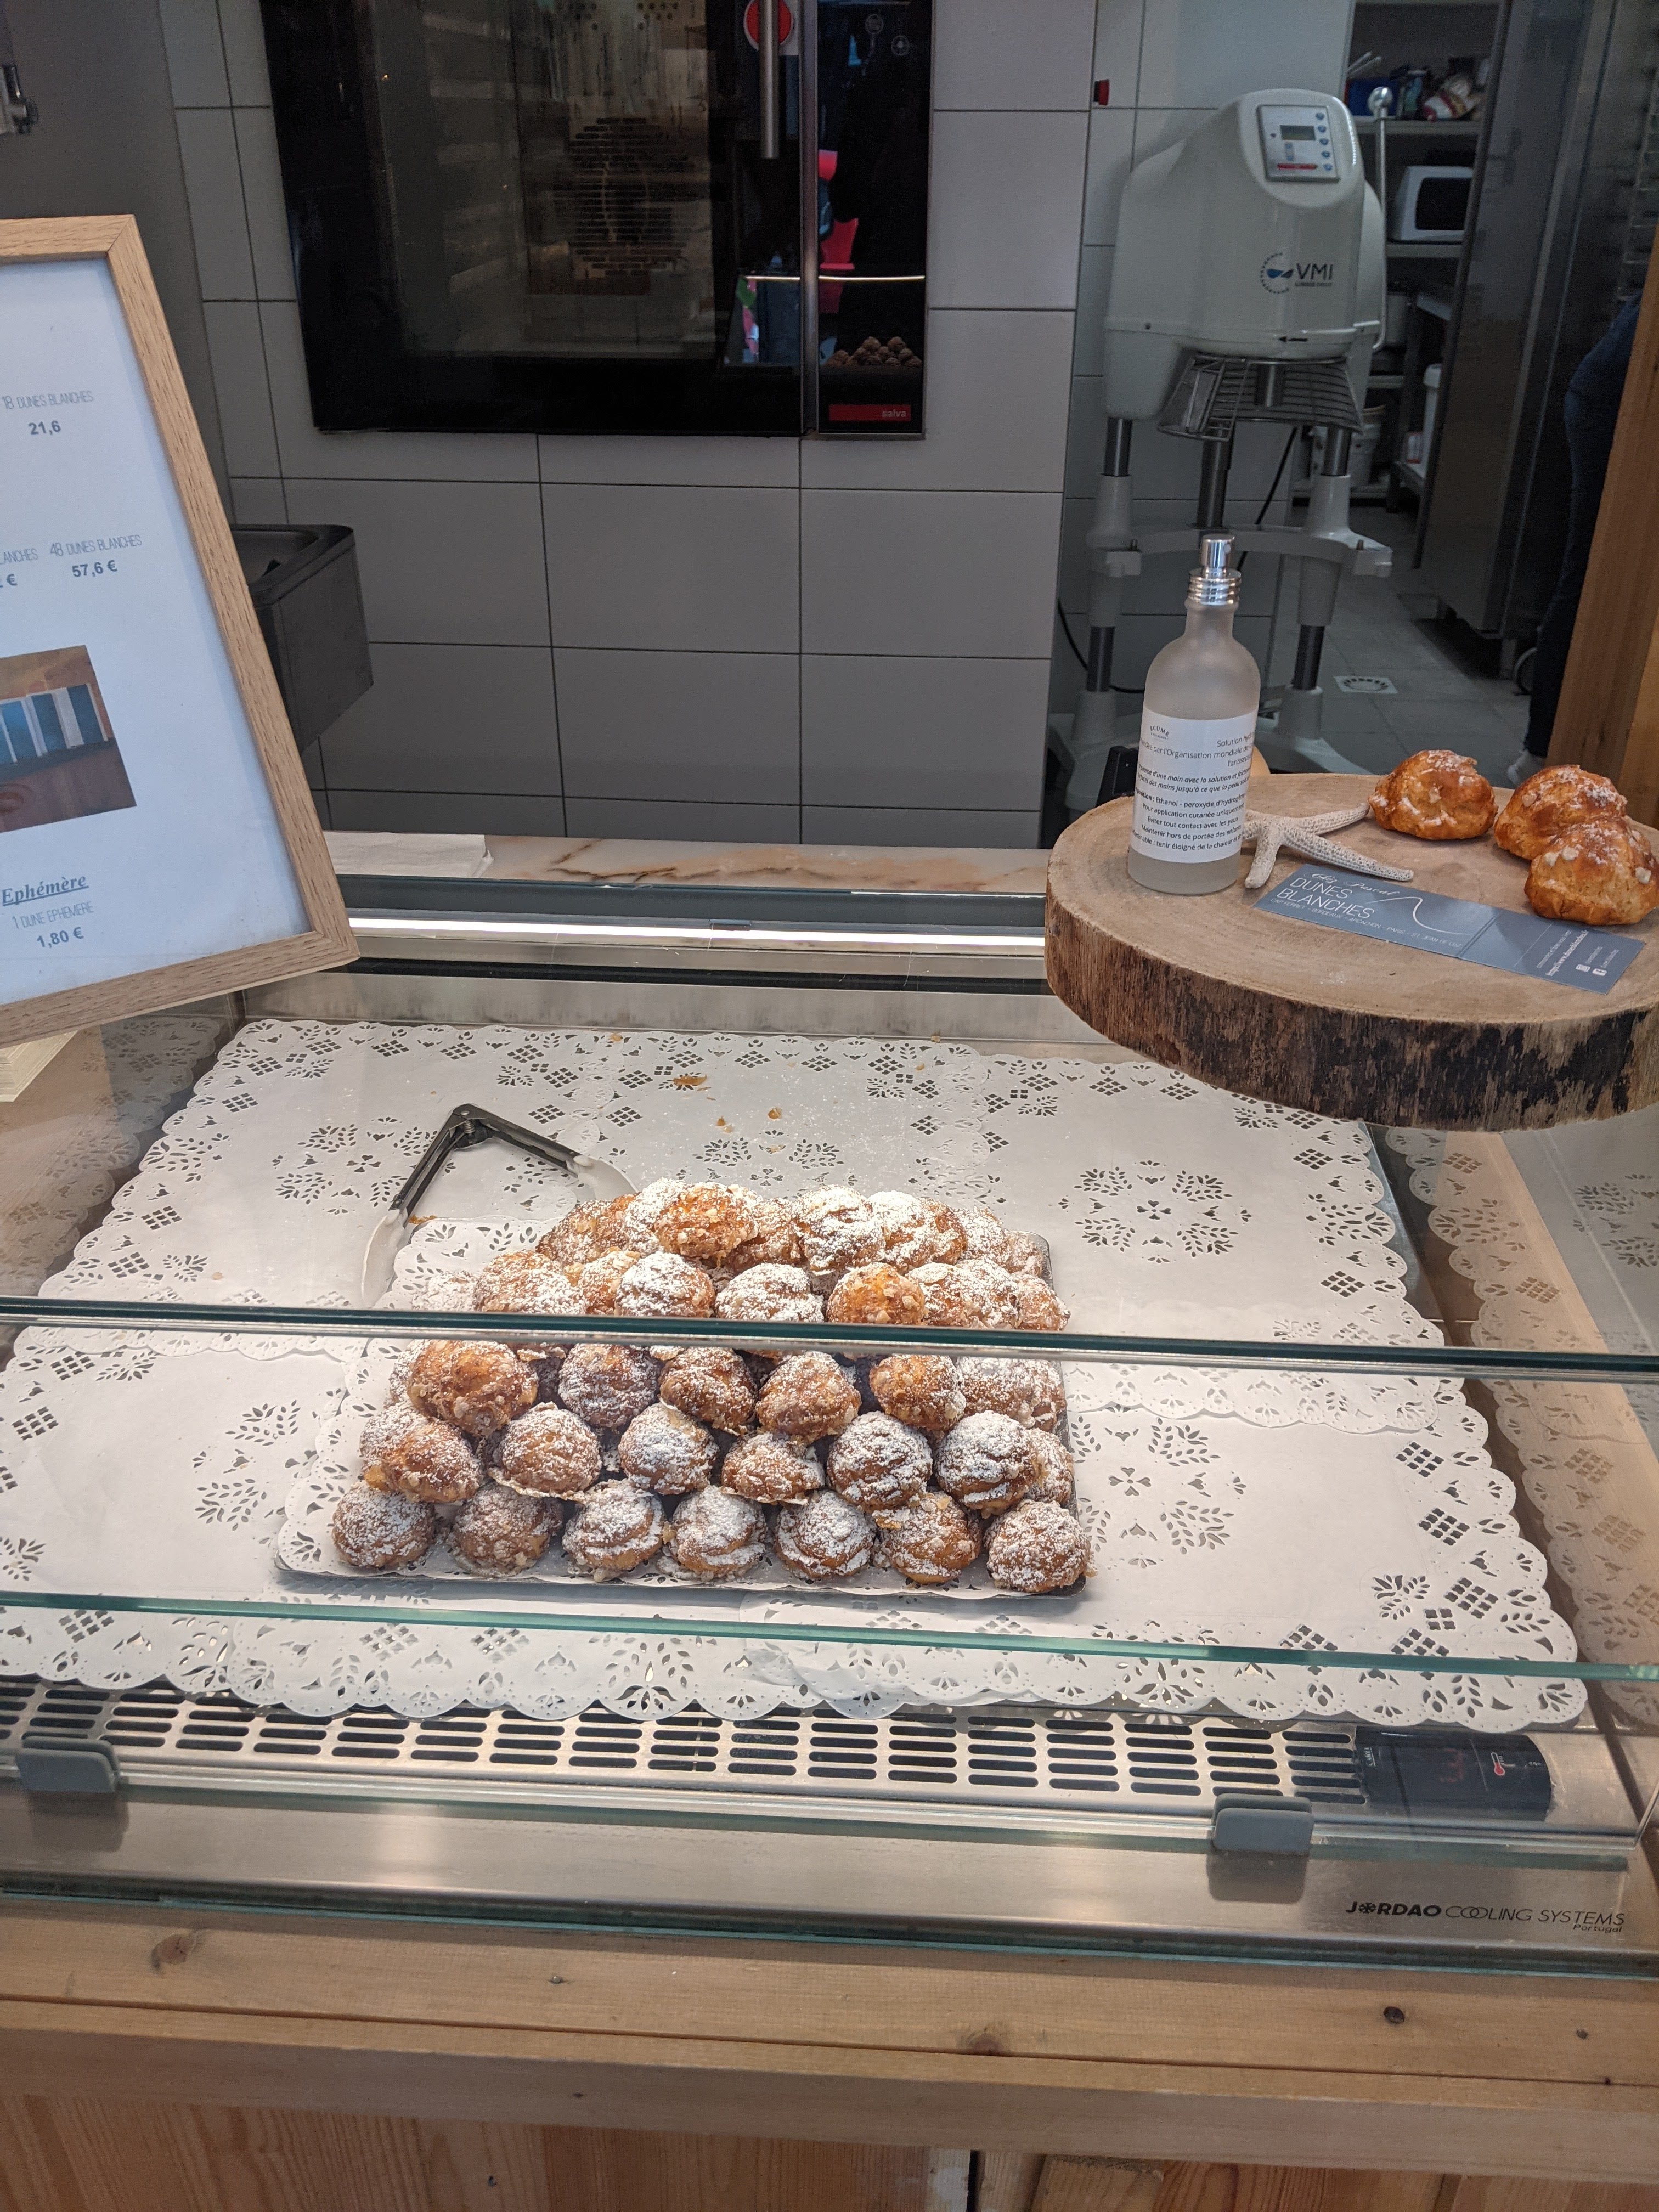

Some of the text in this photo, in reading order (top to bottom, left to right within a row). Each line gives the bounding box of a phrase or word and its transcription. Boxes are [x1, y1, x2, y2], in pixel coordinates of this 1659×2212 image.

[1296, 263, 1333, 280] VMI
[2, 391, 94, 409] 18 DUNES BLANCHES
[882, 409, 907, 417] salva
[28, 420, 61, 435] 21,6
[49, 534, 143, 556] 48 DUNES BLANCHES
[107, 560, 118, 572] €
[1217, 737, 1242, 747] Solution
[1164, 747, 1212, 759] l'Organisation
[1214, 747, 1242, 758] mondiale
[1228, 782, 1239, 791] peau
[1155, 797, 1178, 806] Ethanol
[1143, 803, 1153, 811] Pour
[1154, 808, 1187, 818] application
[1216, 803, 1244, 816] uniquement
[1147, 816, 1162, 825] Eviter
[1228, 817, 1238, 826] yeux
[1141, 824, 1166, 837] Maintenir
[1193, 833, 1214, 841] portée
[1214, 839, 1233, 848] chaleur
[2, 876, 88, 905] Ephémère
[1289, 877, 1352, 899] DUNES
[1276, 888, 1375, 919] BLANCHES
[20, 911, 46, 928] DUNE
[47, 901, 94, 922] EPHEMERE
[37, 927, 84, 948] 1,80 €
[1445, 1905, 1533, 1921] COOLING
[1538, 1909, 1625, 1925] SYSTEMS
[1573, 1923, 1622, 1933] Portugal
